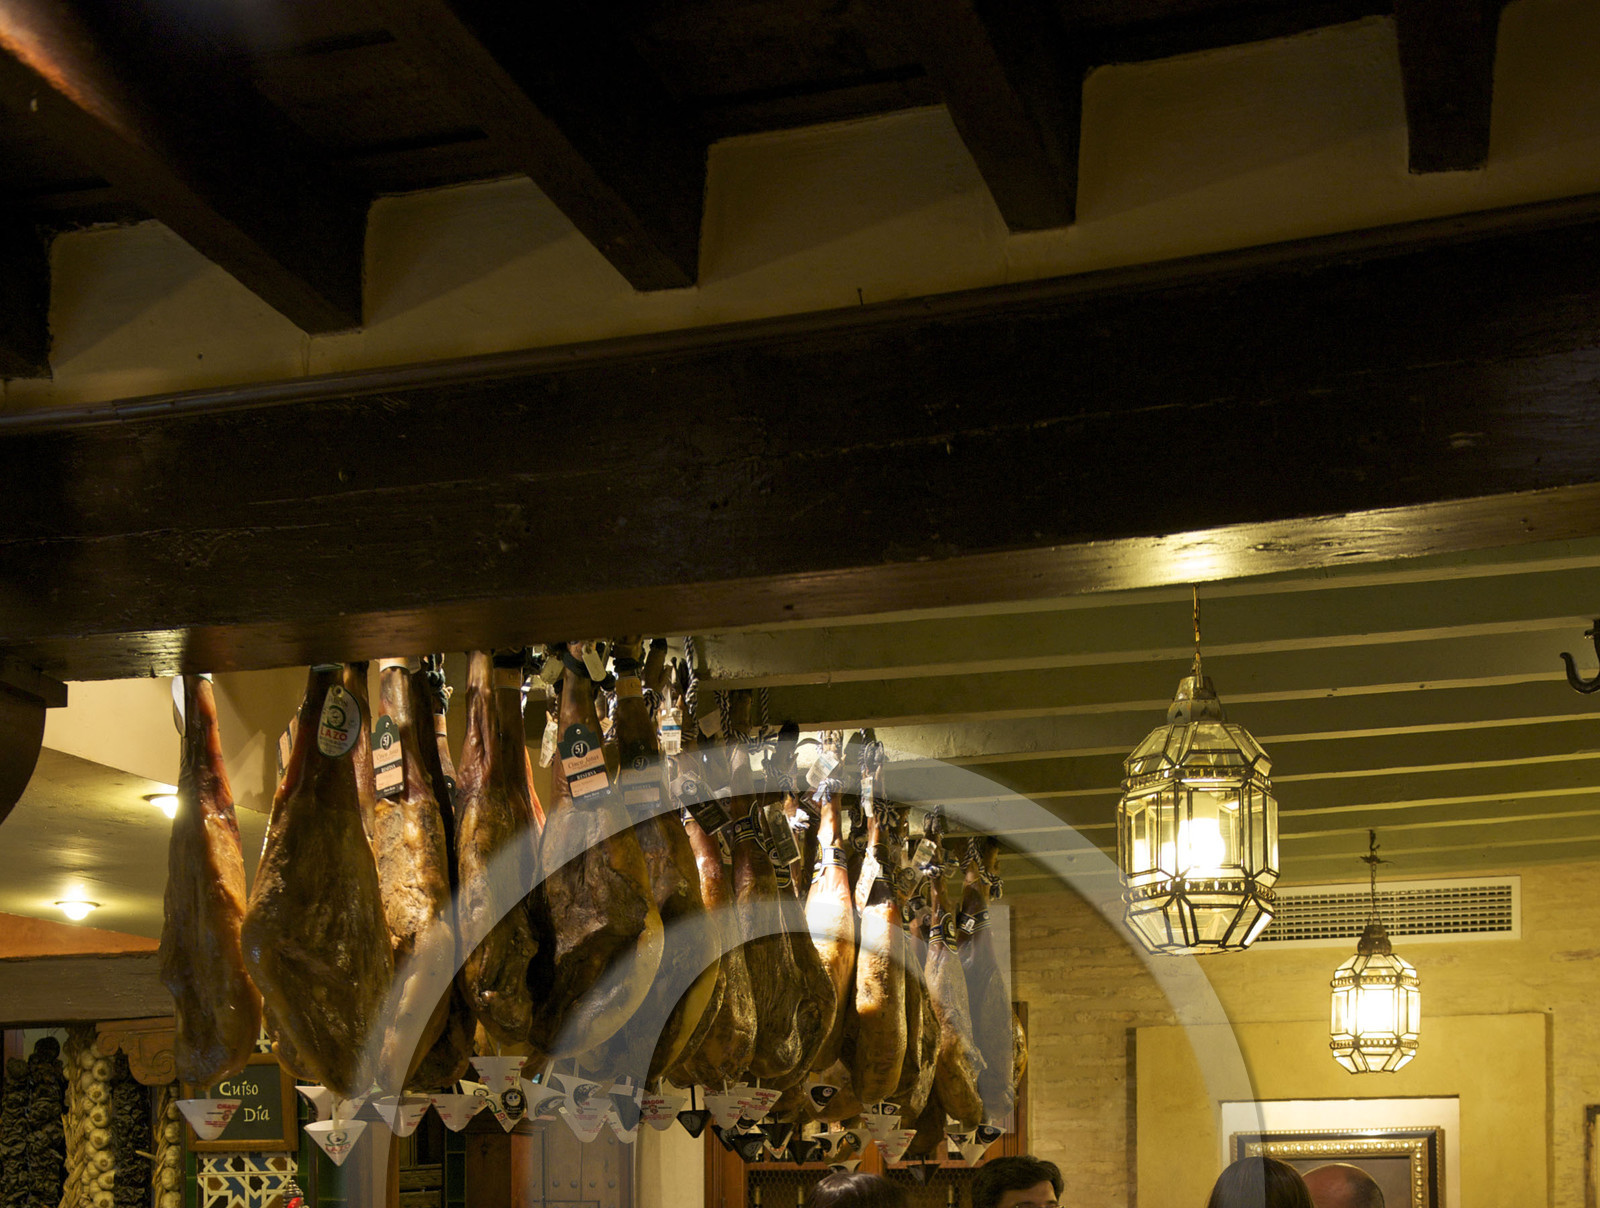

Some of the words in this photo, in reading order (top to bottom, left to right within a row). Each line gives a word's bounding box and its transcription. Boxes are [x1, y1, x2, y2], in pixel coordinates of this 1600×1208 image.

[320, 728, 348, 741] LAZO
[574, 744, 584, 754] 5J
[576, 770, 597, 780] RESERVA
